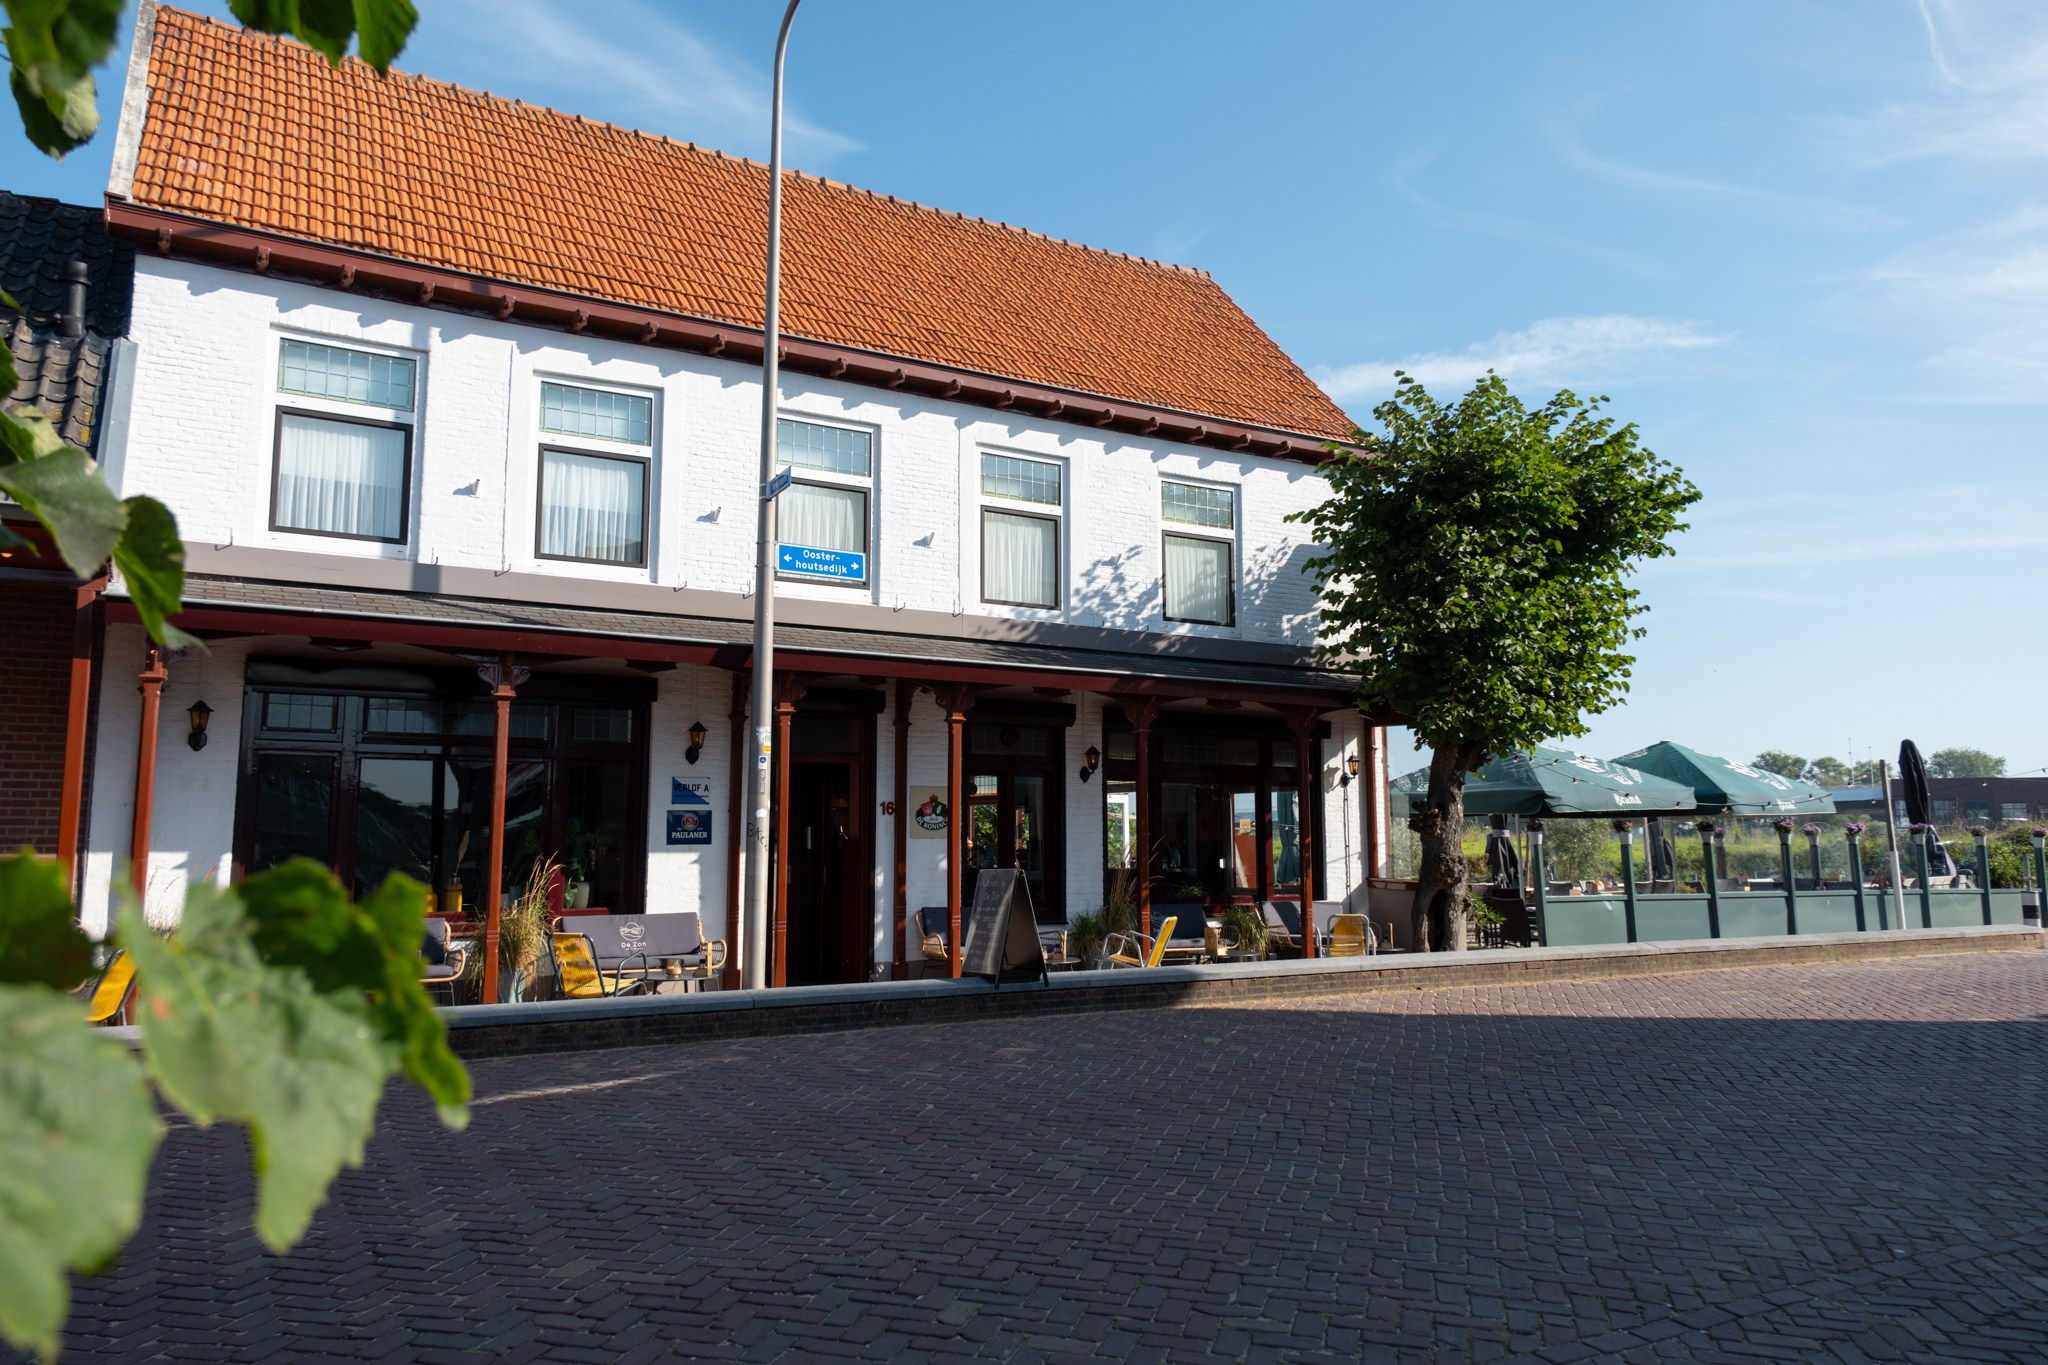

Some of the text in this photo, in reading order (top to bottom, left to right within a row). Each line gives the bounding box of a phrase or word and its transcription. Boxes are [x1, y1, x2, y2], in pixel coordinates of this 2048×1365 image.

[803, 549, 840, 561] Ooster-
[795, 560, 848, 575] houtsedijk
[673, 783, 709, 792] VERLOF A
[880, 801, 895, 816] 16
